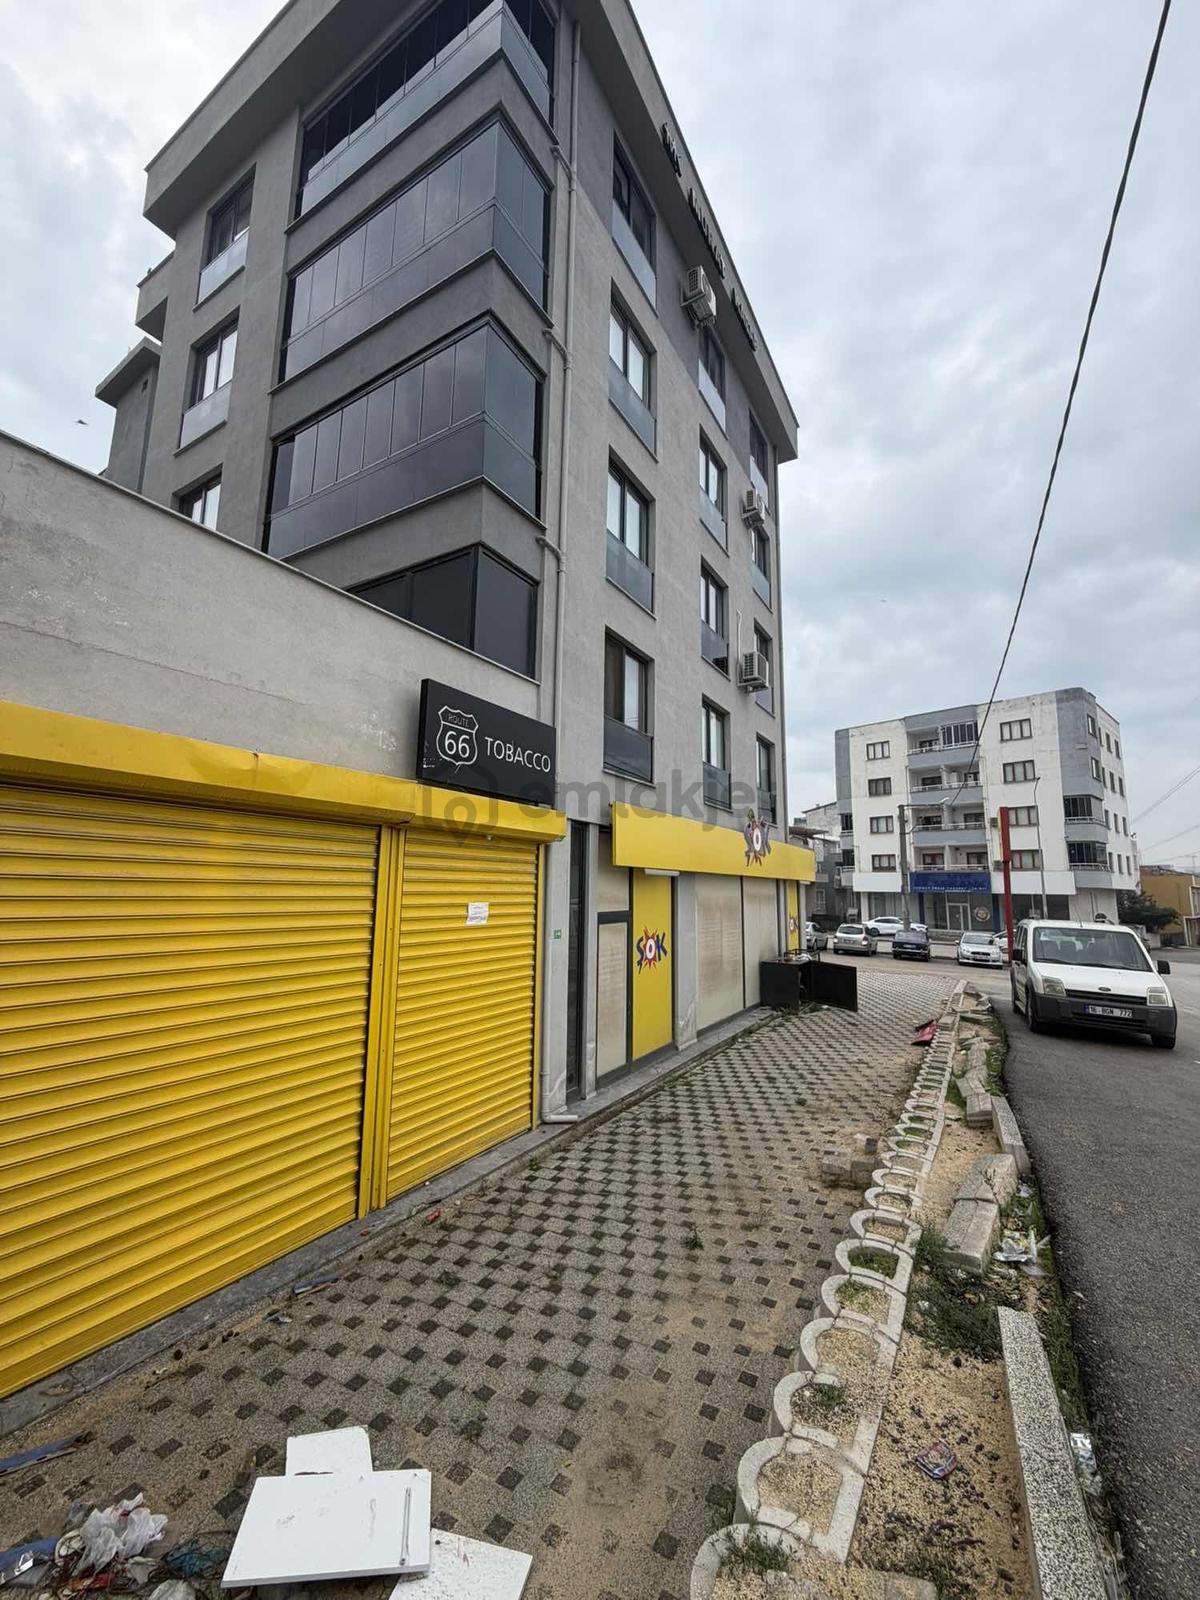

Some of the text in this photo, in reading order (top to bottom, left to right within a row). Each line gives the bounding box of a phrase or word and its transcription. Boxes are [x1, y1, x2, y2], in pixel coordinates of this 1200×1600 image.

[447, 713, 470, 728] ROUTE
[444, 731, 470, 758] 66
[484, 736, 551, 773] TOBACCO
